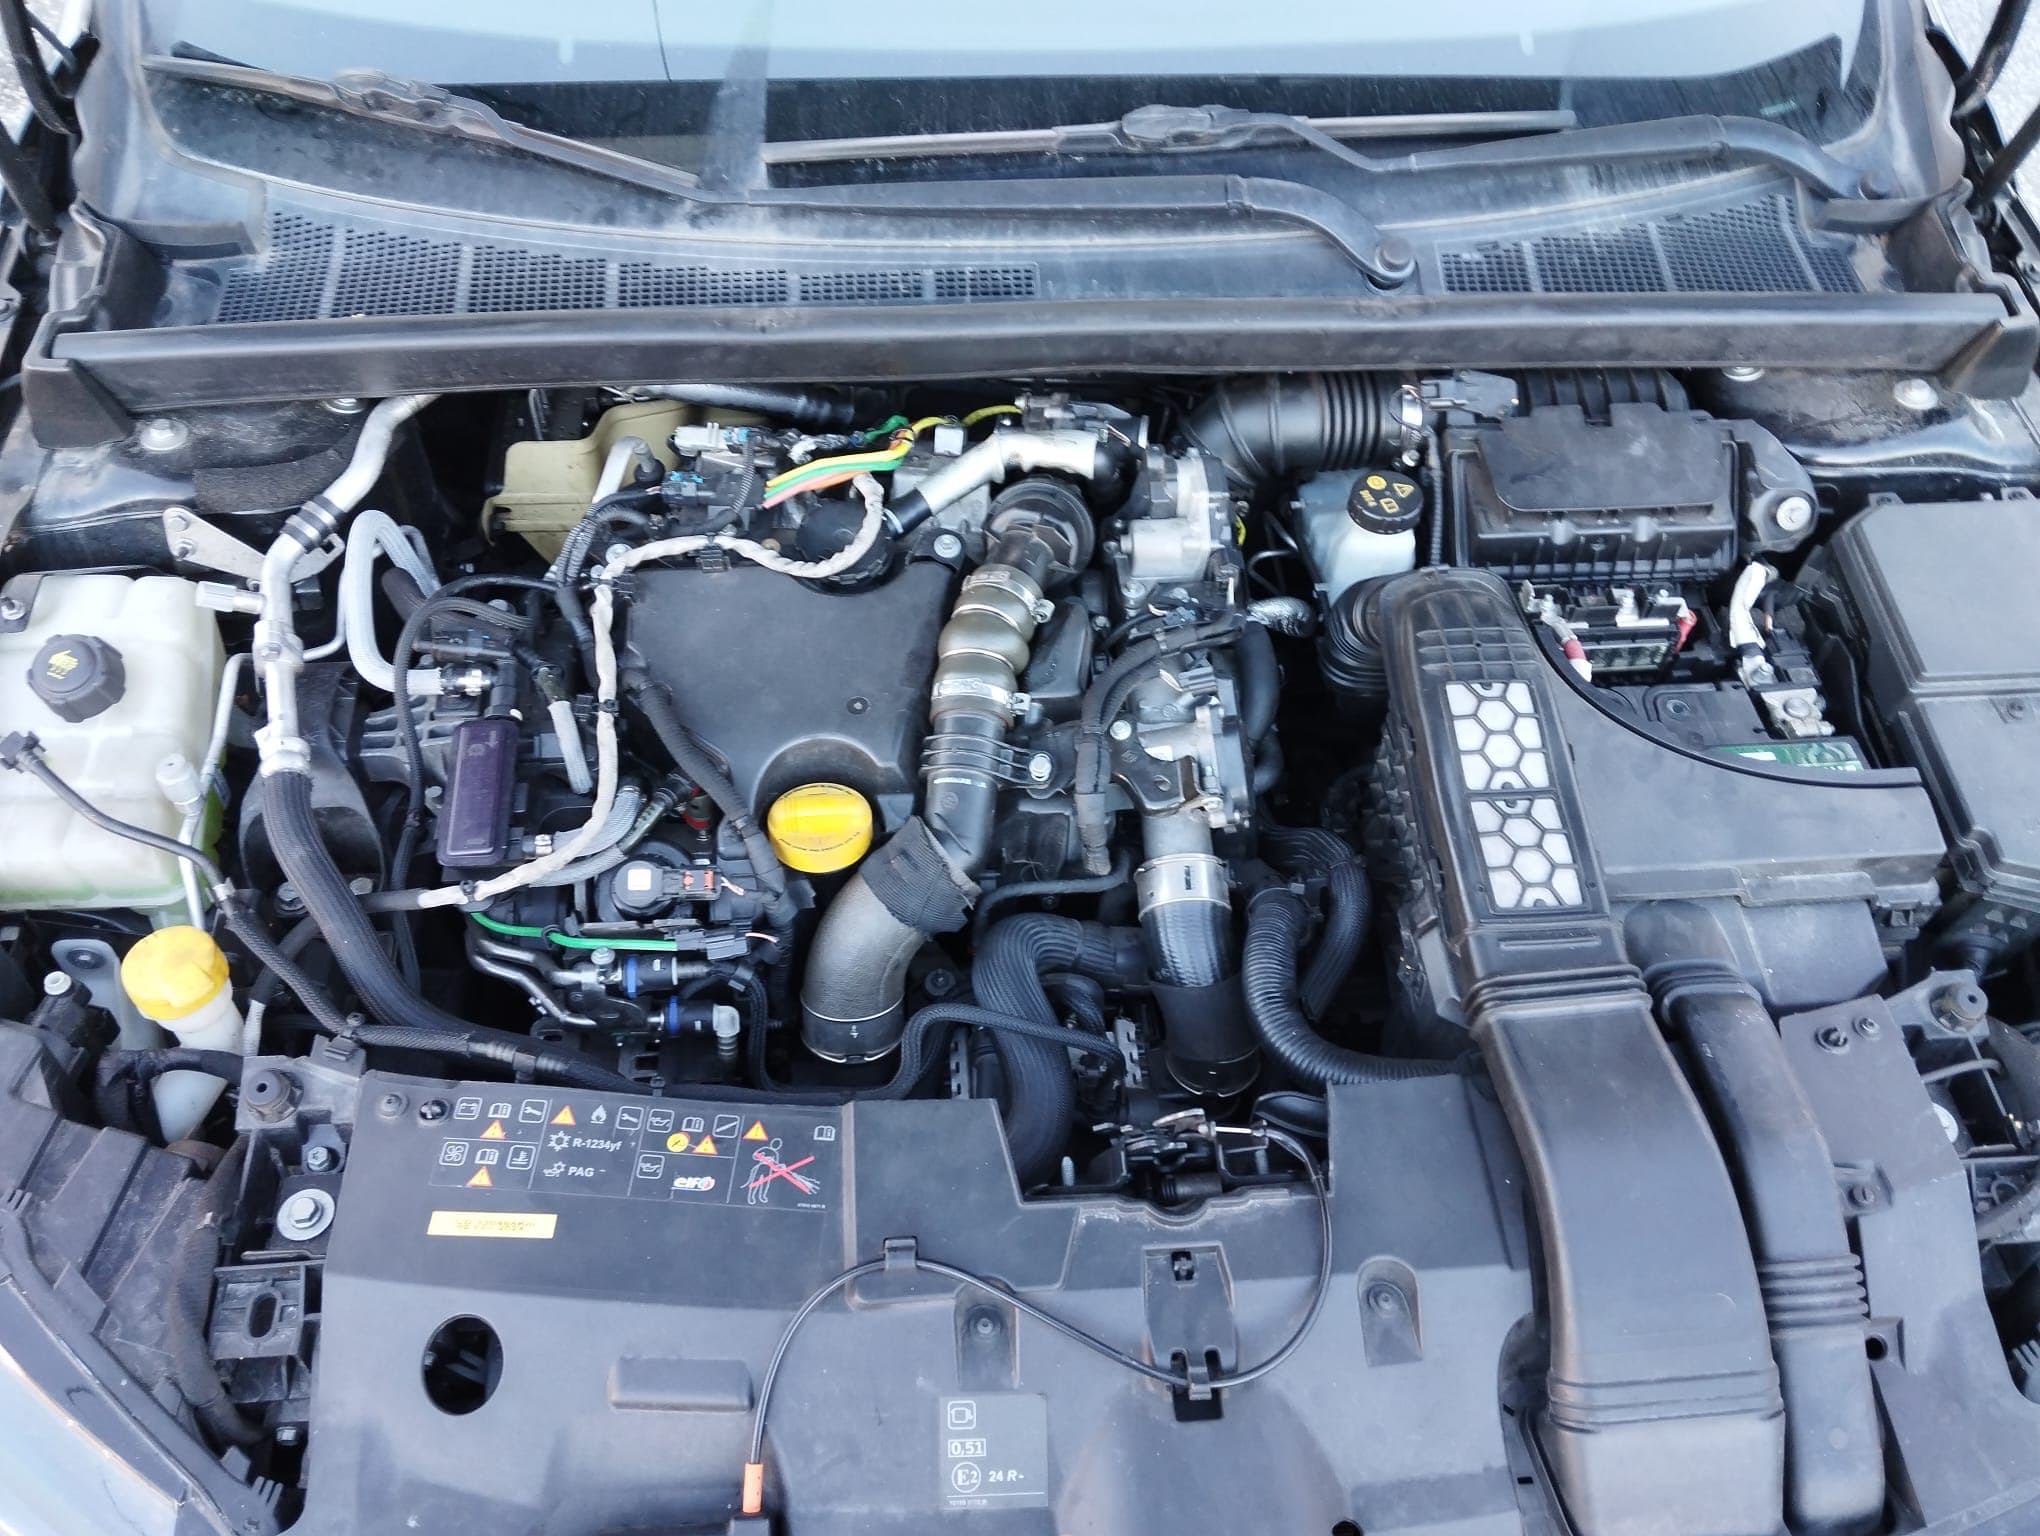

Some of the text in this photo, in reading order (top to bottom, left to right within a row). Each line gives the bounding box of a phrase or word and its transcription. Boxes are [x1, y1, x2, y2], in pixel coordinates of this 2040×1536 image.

[572, 1137, 623, 1152] R-1234yf
[567, 1166, 595, 1177] PAG
[673, 1176, 703, 1189] elf
[957, 1469, 978, 1486] E2
[988, 1470, 1004, 1482] 24
